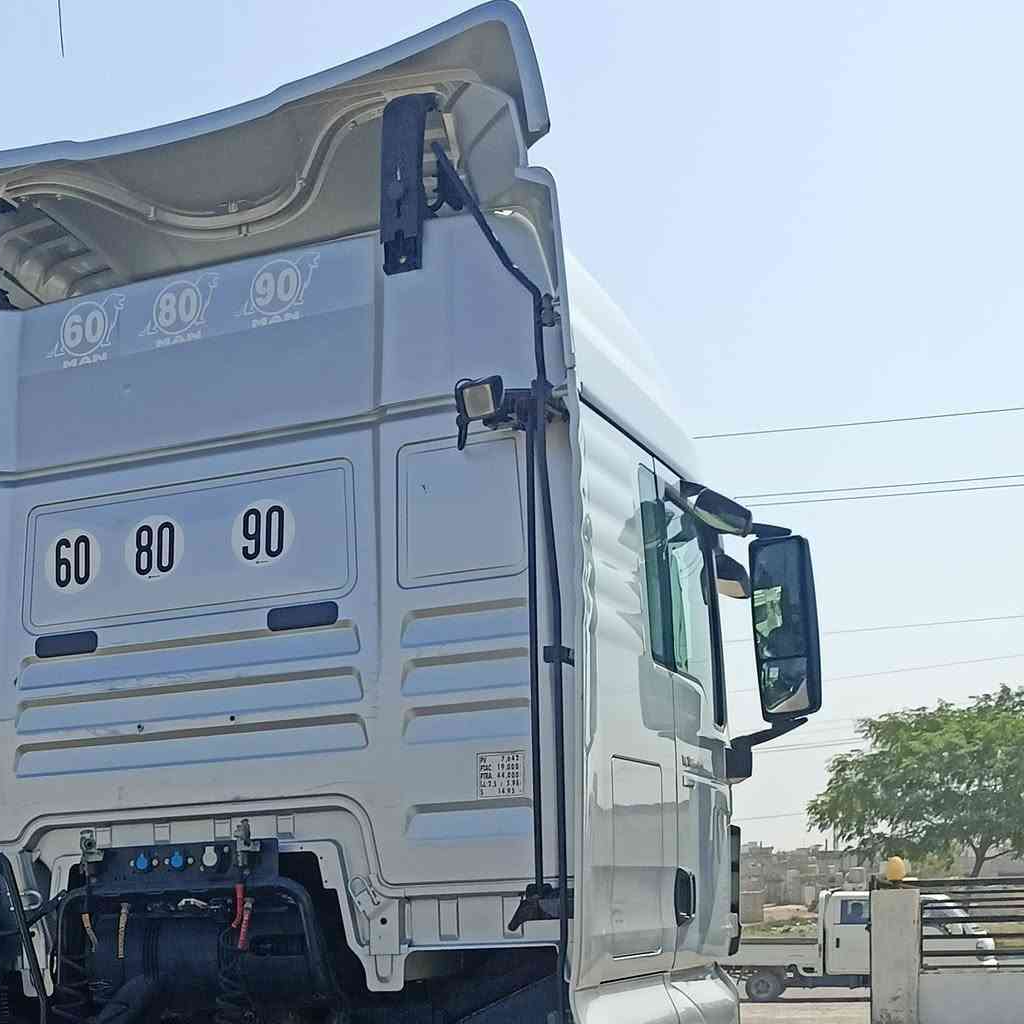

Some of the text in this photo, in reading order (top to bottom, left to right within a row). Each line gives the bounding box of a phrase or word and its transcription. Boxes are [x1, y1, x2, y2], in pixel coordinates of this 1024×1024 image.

[254, 266, 298, 305] 90
[158, 287, 200, 326] 80
[253, 310, 301, 328] MAN
[64, 310, 106, 348] 60
[156, 329, 203, 347] MAN
[62, 351, 108, 368] MAN
[55, 505, 285, 588] 60 80 90
